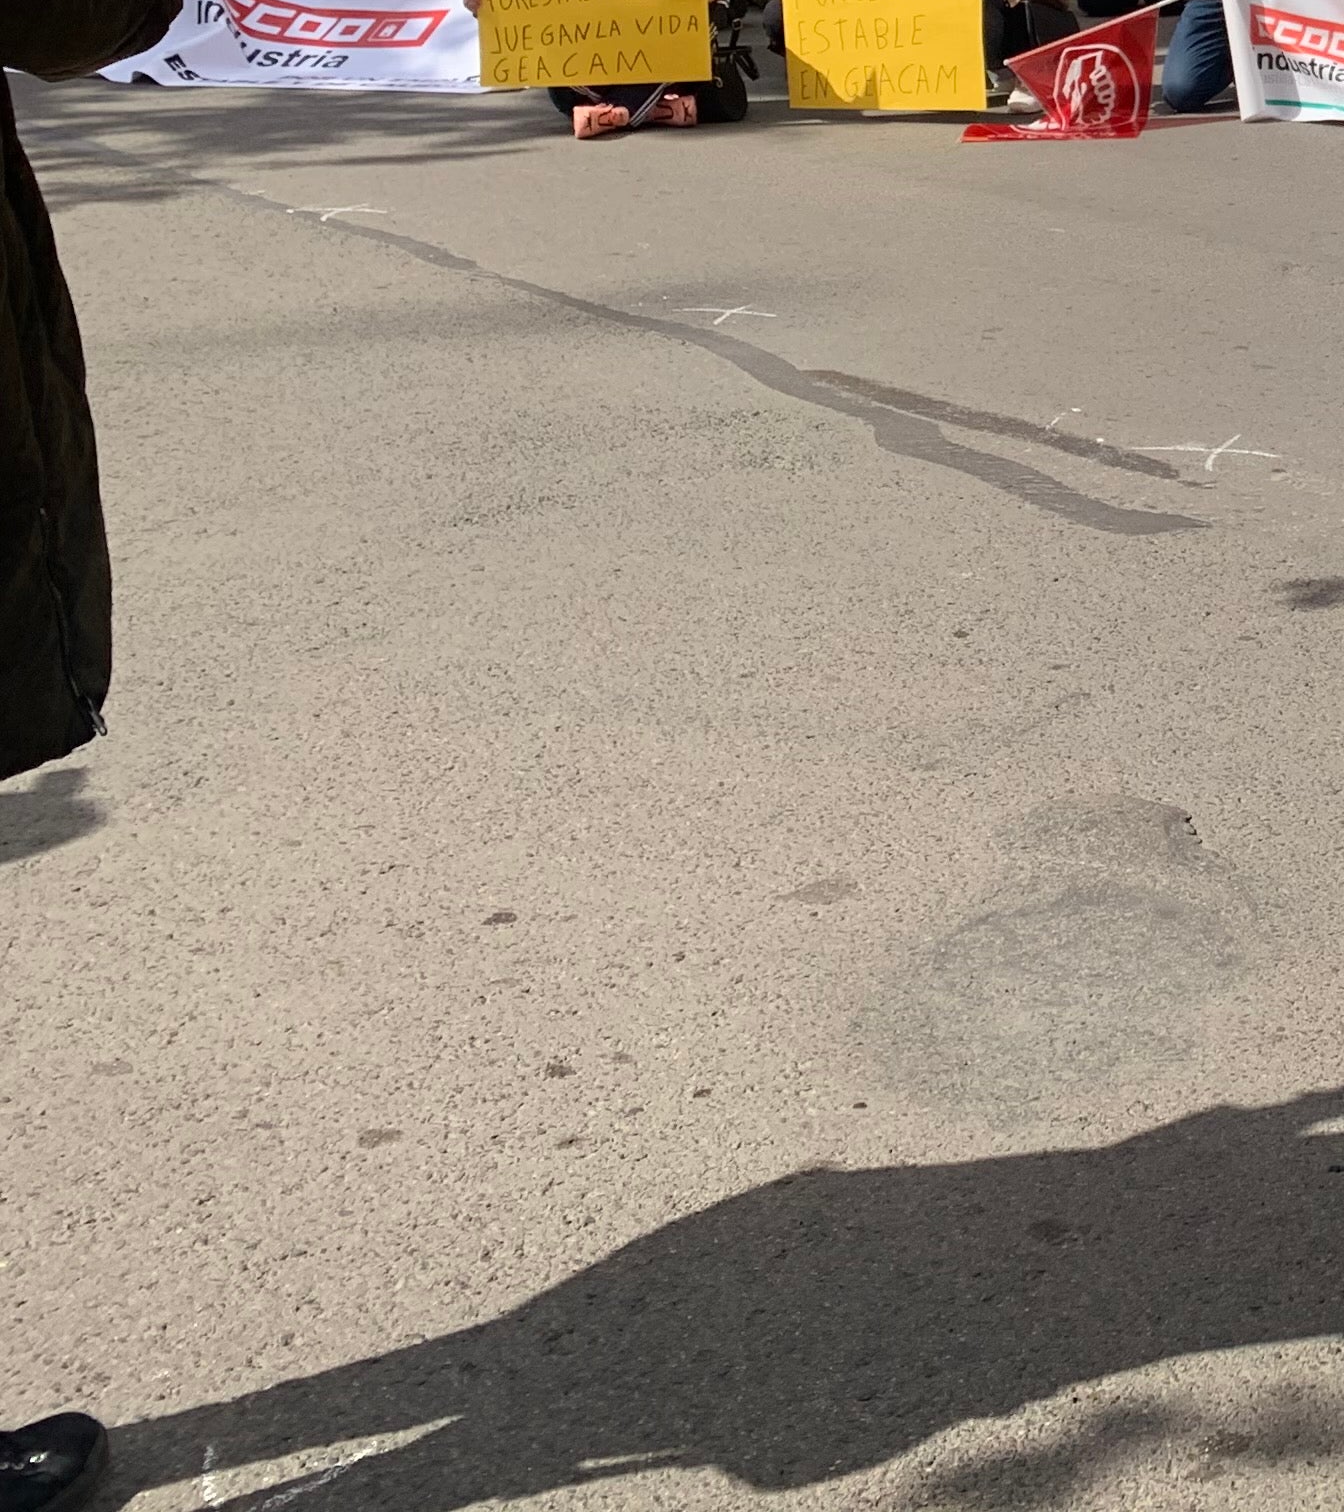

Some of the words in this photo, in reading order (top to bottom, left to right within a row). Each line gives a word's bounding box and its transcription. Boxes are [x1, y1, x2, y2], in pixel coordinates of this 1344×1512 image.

[635, 14, 699, 35] VIDA
[798, 14, 926, 56] ESTABLE
[493, 49, 652, 83] GEACAM
[800, 70, 829, 101] EN
[843, 64, 959, 103] GEACAM
